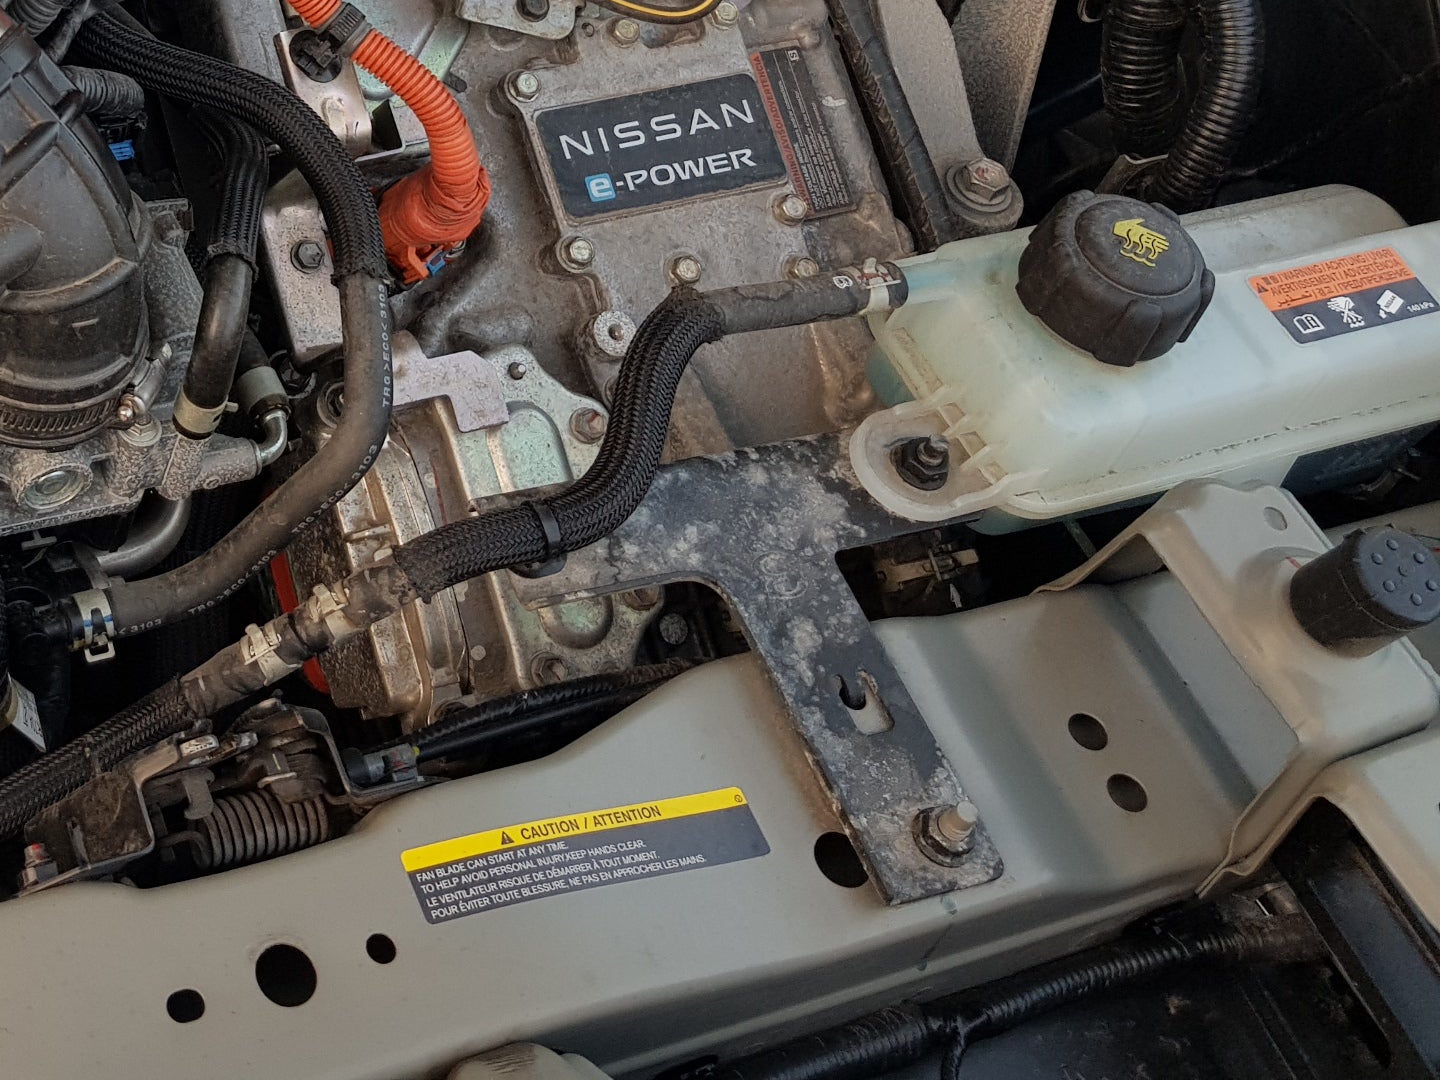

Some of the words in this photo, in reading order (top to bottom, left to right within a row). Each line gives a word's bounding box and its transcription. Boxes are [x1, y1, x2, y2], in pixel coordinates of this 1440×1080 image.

[559, 99, 755, 160] NISSAN
[589, 148, 757, 199] e-POWER
[521, 819, 580, 840] CAUTION
[594, 805, 662, 828] ATTENTION
[416, 871, 436, 882] FAN
[437, 863, 466, 877] BLADE
[467, 857, 487, 871] CAN
[488, 851, 515, 865] START
[517, 848, 528, 858] AT
[529, 844, 546, 856] ANY
[421, 882, 434, 894] TO
[436, 877, 459, 891] HELP
[461, 871, 488, 885] AVOID
[489, 862, 537, 878] PERSONAL
[588, 845, 617, 858] HANDS
[617, 839, 647, 852] CLEAR.
[426, 896, 437, 908] LE
[438, 883, 497, 904] VENTILATEUR
[498, 874, 532, 889] RISQUE
[533, 871, 546, 882] DE
[546, 862, 593, 880] DÉMARRER
[593, 859, 601, 870] À
[601, 857, 621, 869] TOUT
[622, 850, 660, 864] MOMENT.
[431, 905, 459, 919] POUR
[459, 896, 490, 913] ÉVITER
[491, 889, 521, 903] TOUTE
[521, 880, 569, 897] BLESSURE,
[570, 876, 582, 887] NE
[582, 874, 600, 886] PAS
[600, 871, 613, 881] EN
[613, 861, 662, 879] APPROCHER
[663, 858, 680, 870] LES
